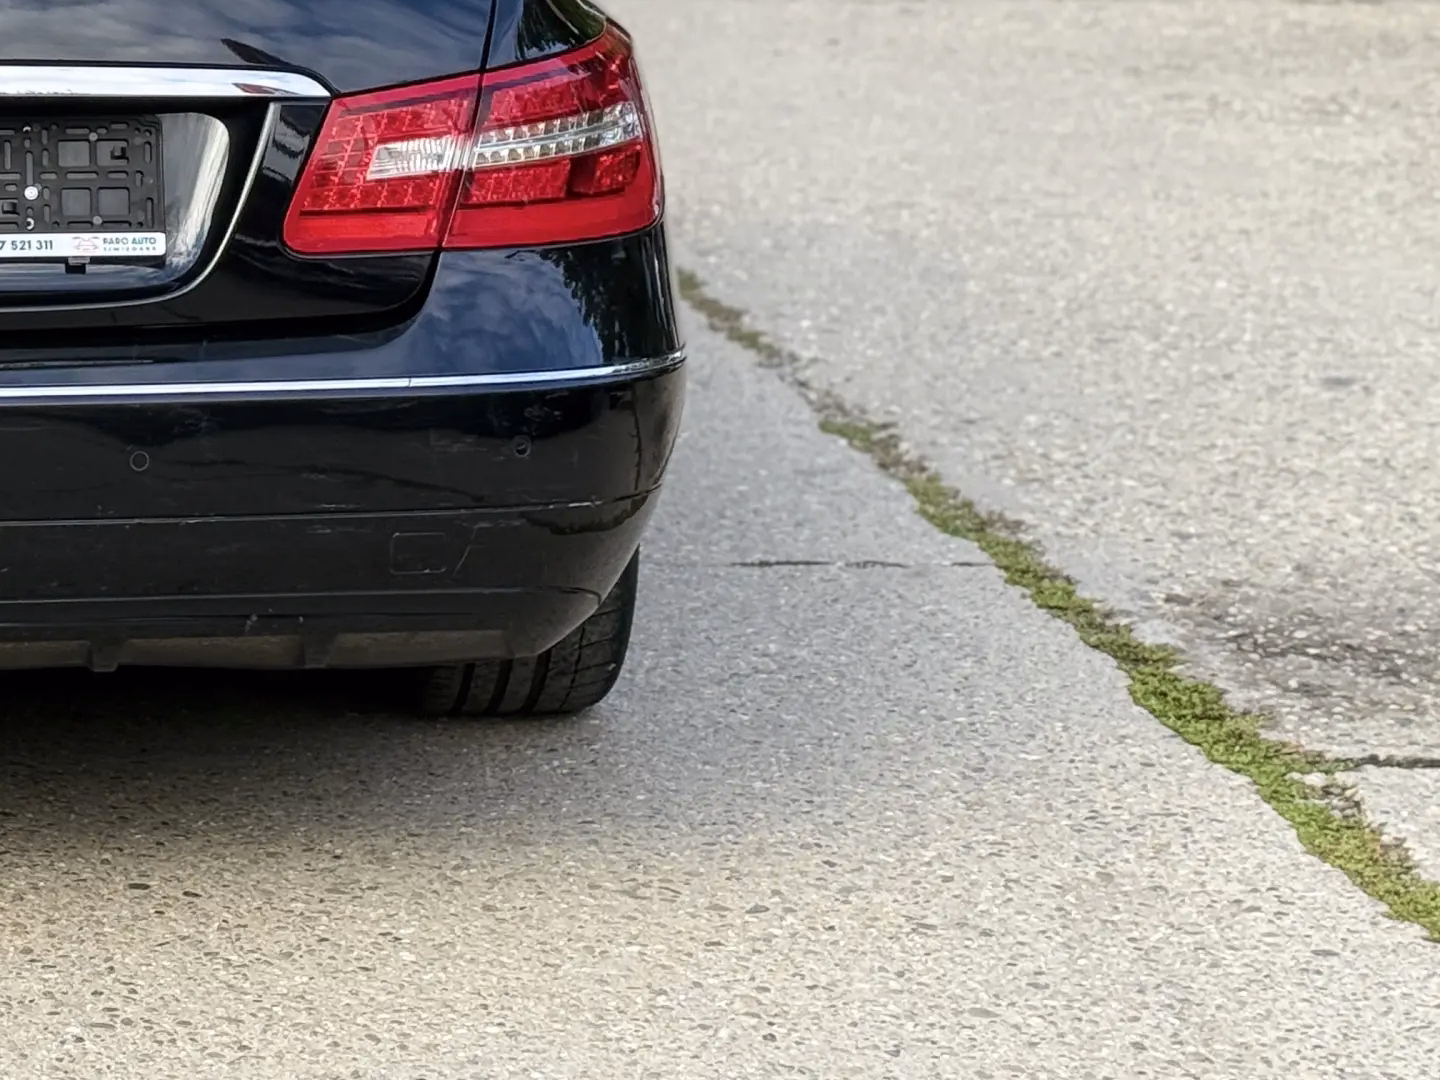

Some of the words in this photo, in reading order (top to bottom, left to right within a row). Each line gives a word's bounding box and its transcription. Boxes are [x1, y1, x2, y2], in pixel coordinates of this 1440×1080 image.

[10, 239, 32, 252] 521
[35, 239, 54, 251] 311
[131, 236, 157, 245] AUTO
